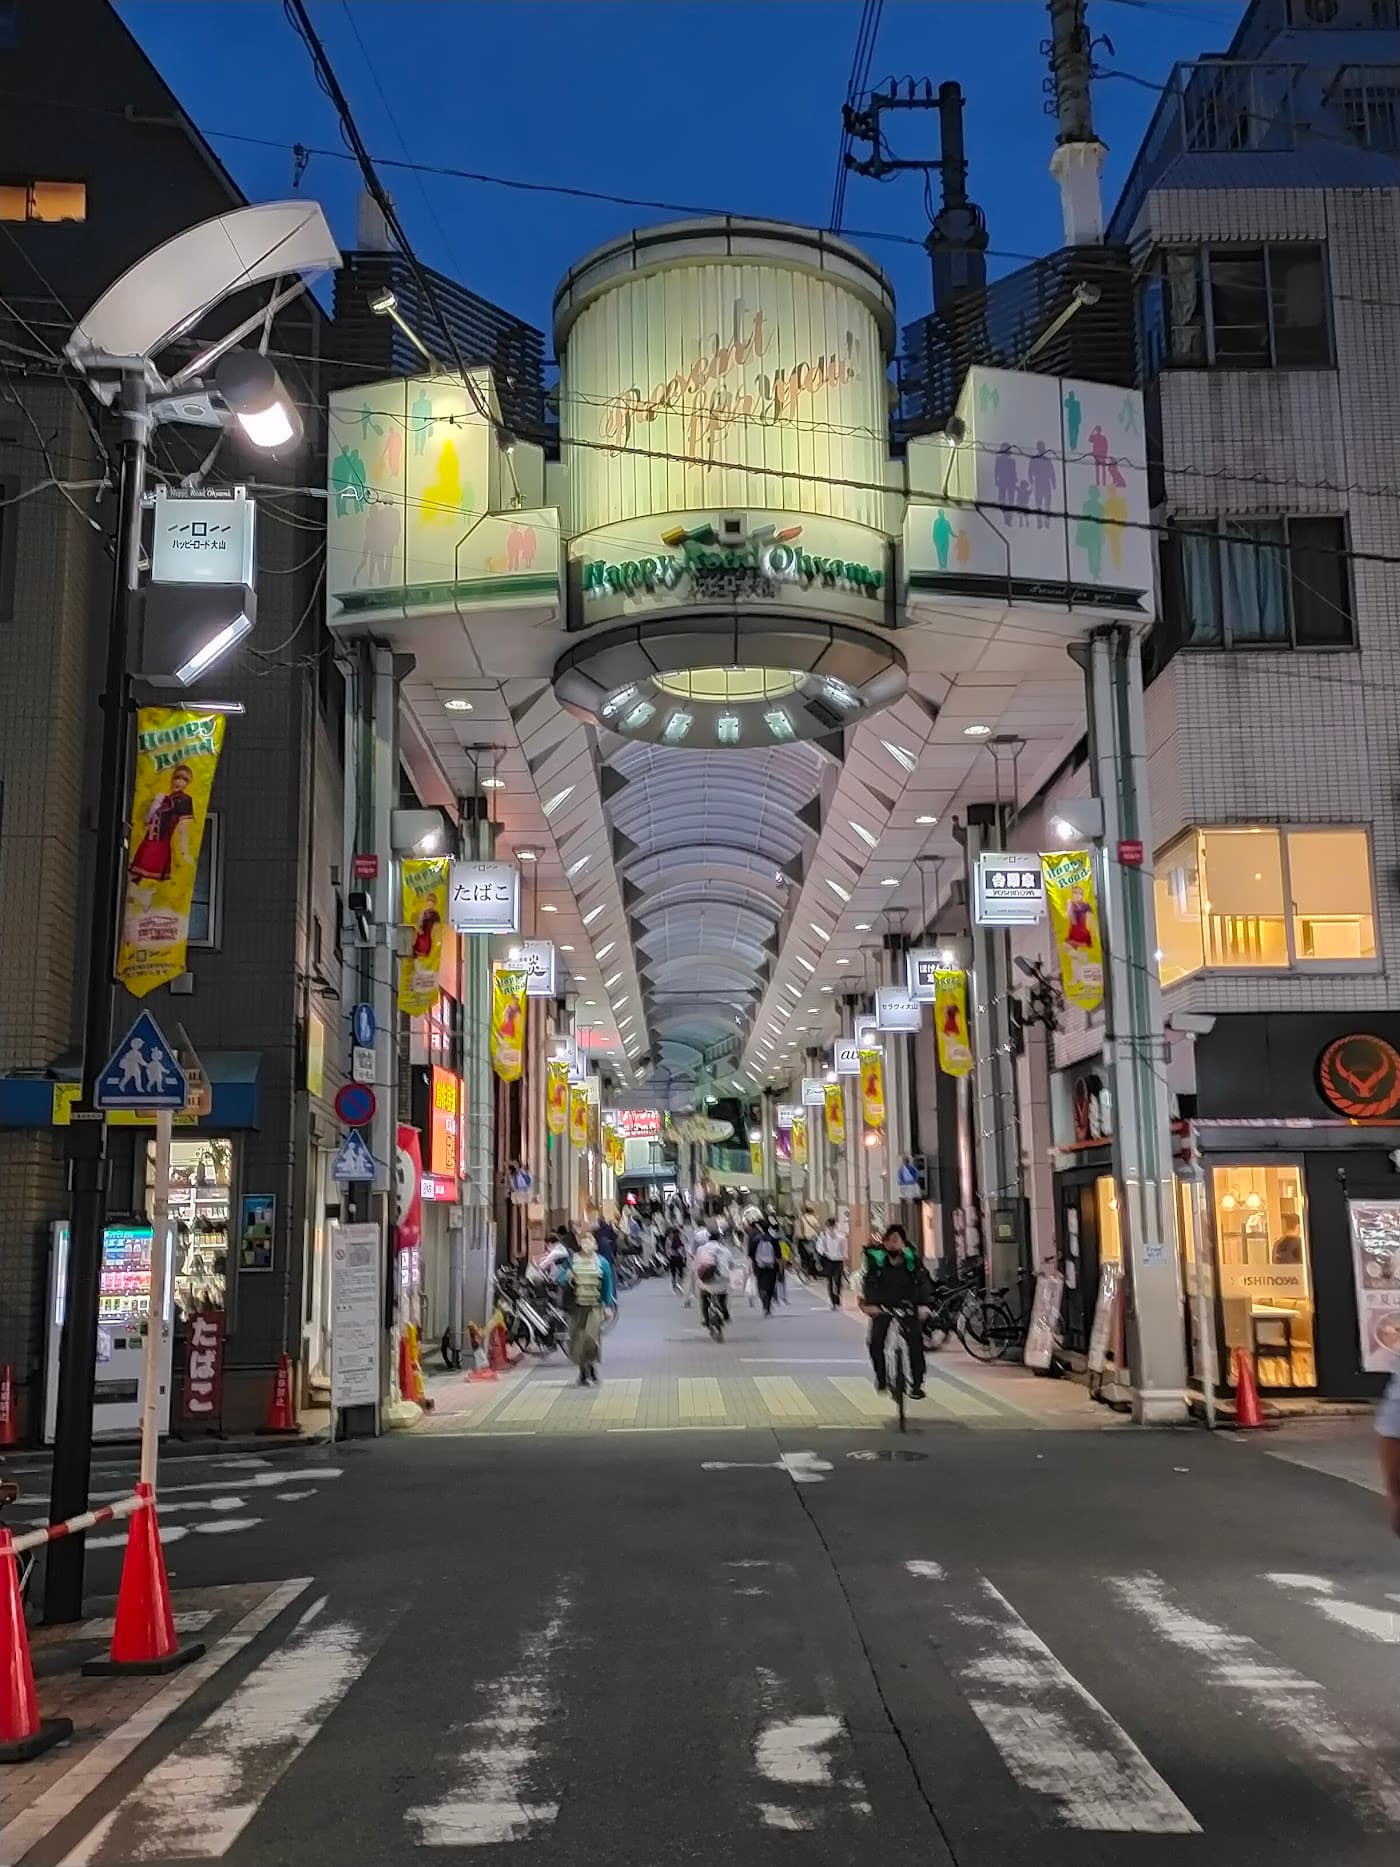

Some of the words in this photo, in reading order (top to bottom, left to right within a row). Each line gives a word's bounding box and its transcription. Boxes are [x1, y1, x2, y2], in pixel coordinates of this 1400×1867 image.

[172, 539, 226, 550] ハッピーロード大山
[583, 553, 682, 594] Happy
[138, 716, 217, 752] Happy
[1046, 857, 1086, 880] Happy
[1059, 867, 1088, 888] Road
[453, 883, 510, 902] たばこ
[189, 1317, 218, 1412] たばこ
